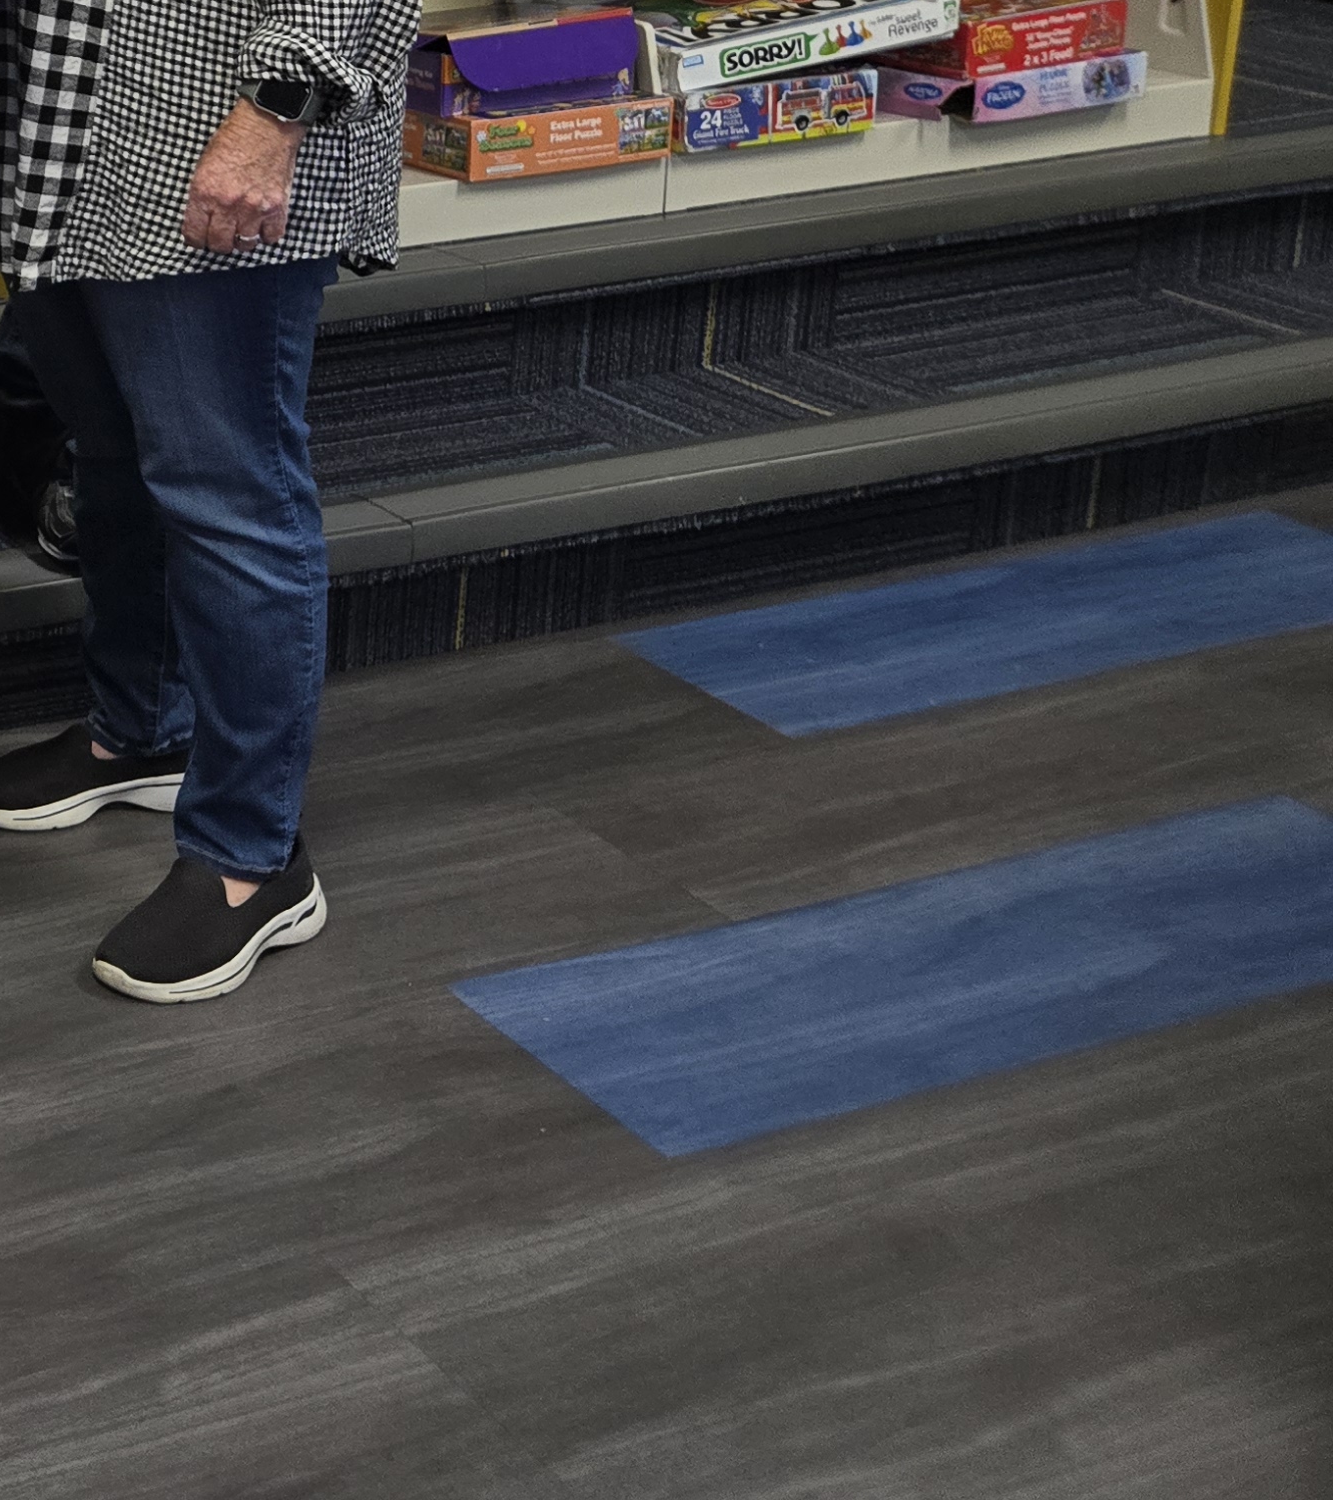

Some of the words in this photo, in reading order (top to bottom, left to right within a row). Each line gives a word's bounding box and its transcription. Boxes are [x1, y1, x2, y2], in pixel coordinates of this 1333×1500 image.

[888, 19, 938, 37] Revenge
[726, 37, 804, 71] SORRY!
[1023, 54, 1031, 66] 2
[1041, 51, 1048, 64] 3
[550, 120, 574, 131] Extra
[576, 117, 602, 130] Large
[700, 110, 721, 130] 24
[550, 132, 573, 143] Floor
[574, 129, 603, 140] Puzzle
[693, 129, 714, 140] Giant
[715, 127, 729, 137] Fire
[730, 124, 749, 135] Truck
